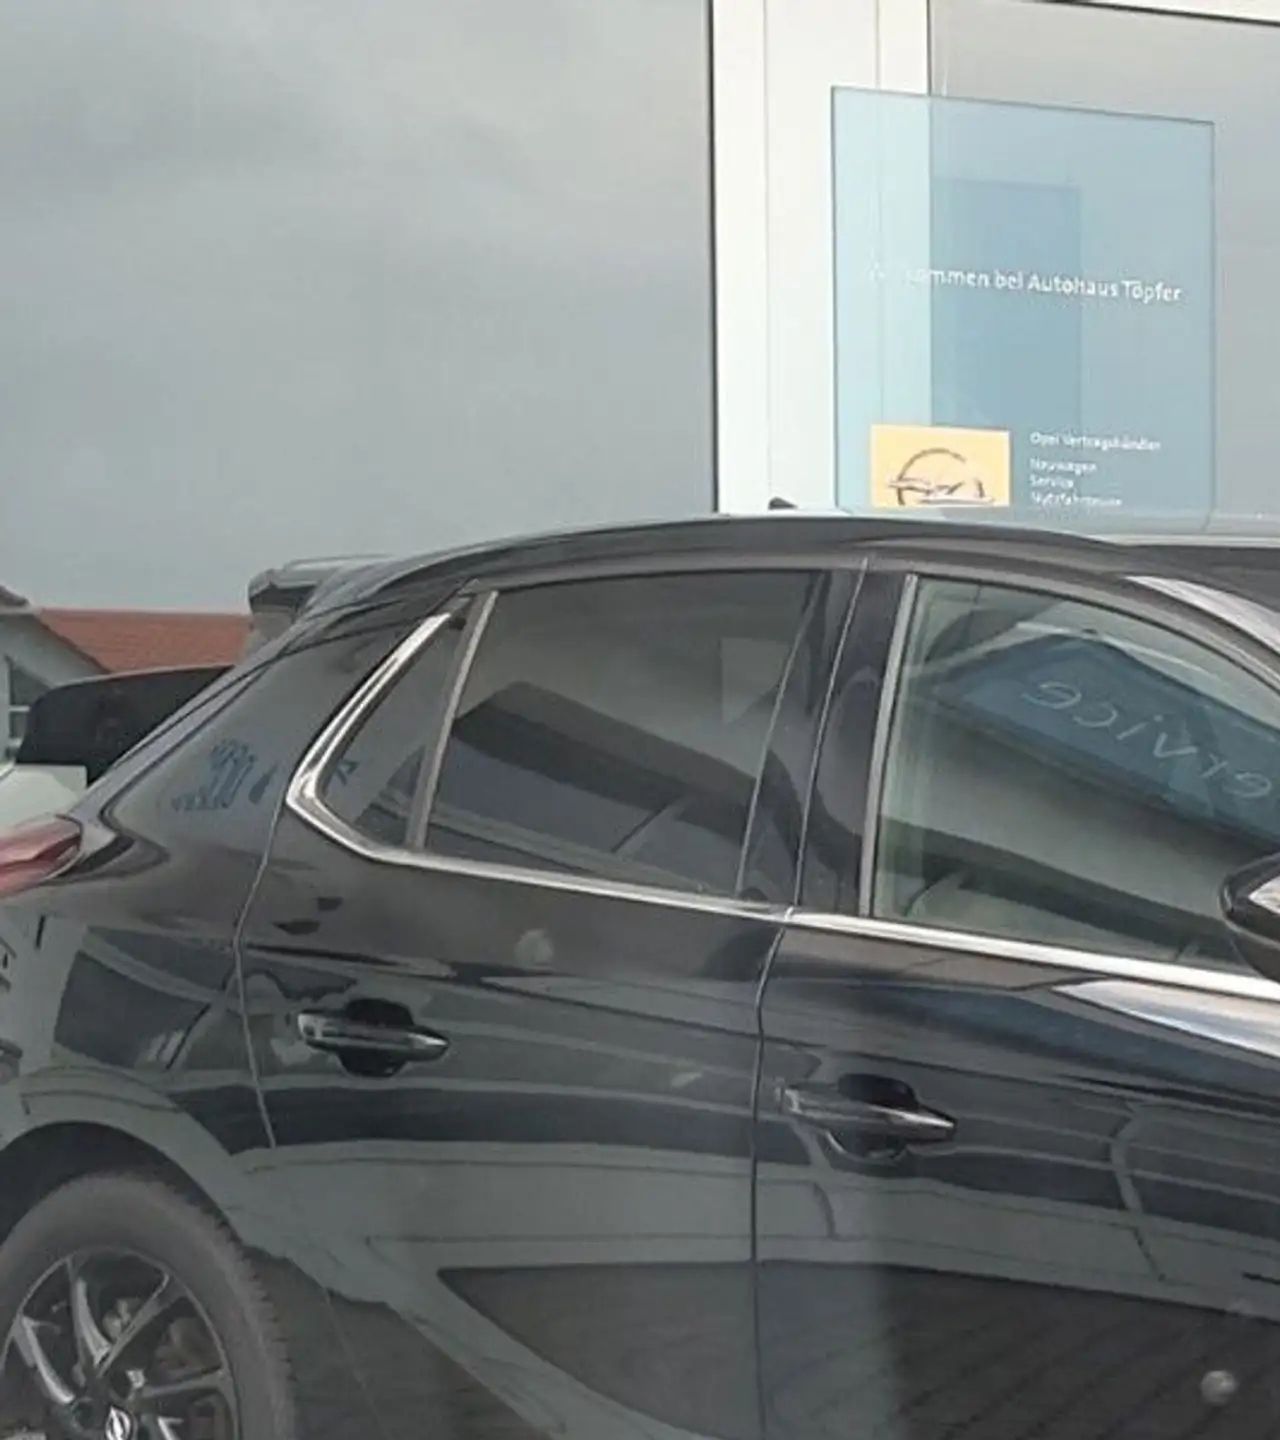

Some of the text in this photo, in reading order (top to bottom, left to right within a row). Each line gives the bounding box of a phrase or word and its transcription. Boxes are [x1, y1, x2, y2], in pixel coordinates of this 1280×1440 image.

[994, 269, 1024, 290] bei
[1027, 272, 1120, 299] Autohaus
[1121, 279, 1183, 304] Töpfer
